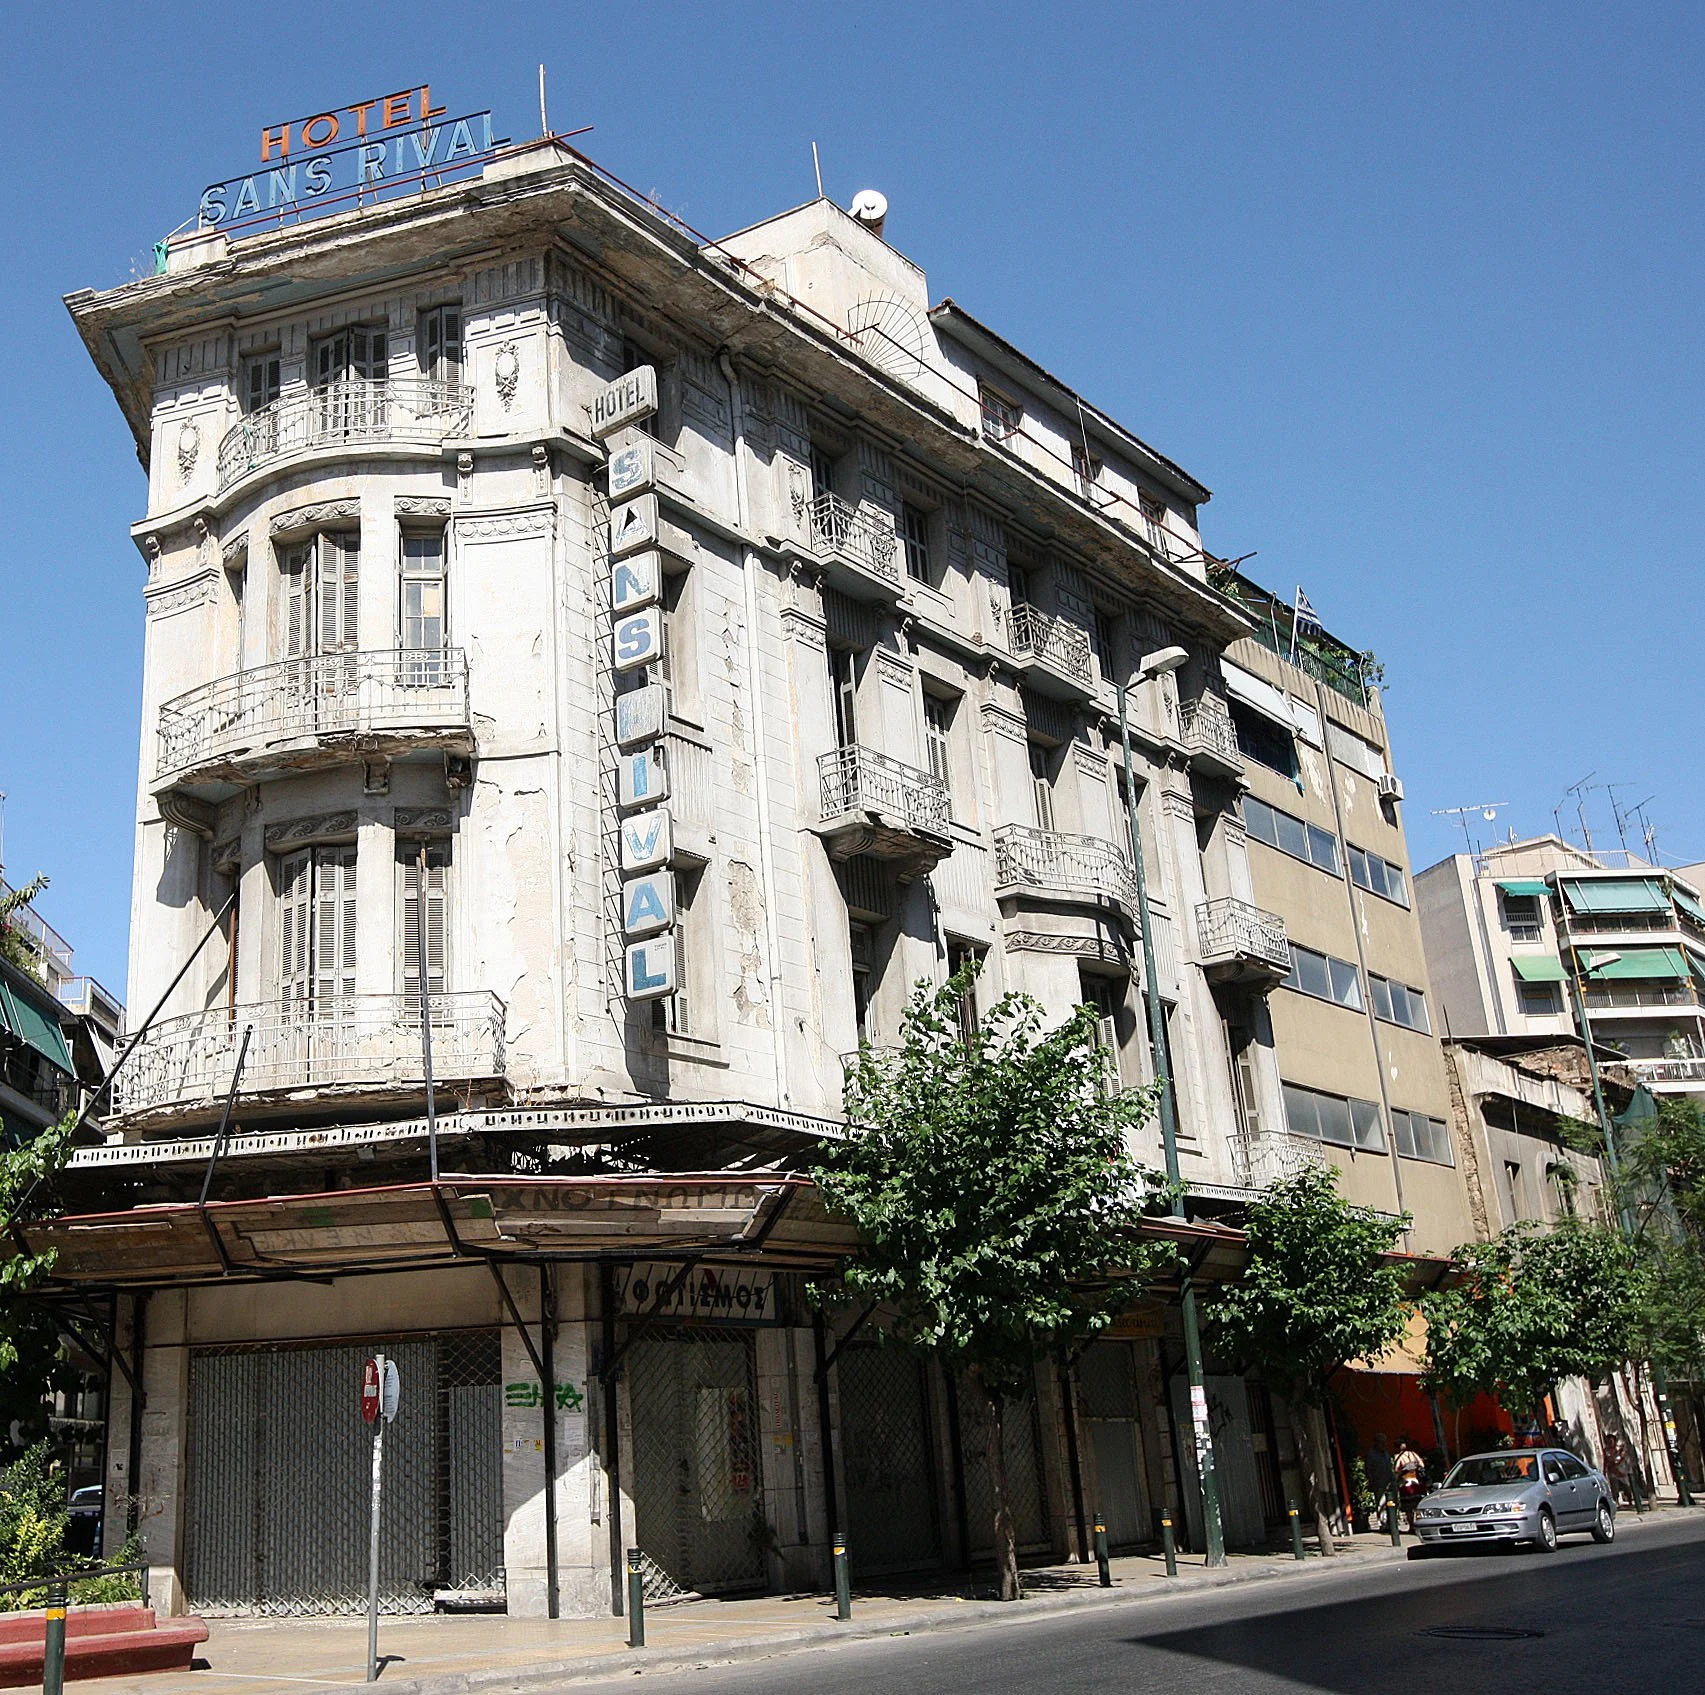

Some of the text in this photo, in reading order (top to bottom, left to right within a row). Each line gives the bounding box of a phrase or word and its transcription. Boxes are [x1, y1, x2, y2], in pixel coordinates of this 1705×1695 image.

[201, 109, 511, 226] SANS RIVAL
[261, 85, 447, 162] HOTEL
[595, 376, 645, 423] HOTEL
[612, 449, 668, 991] SANS IVAL
